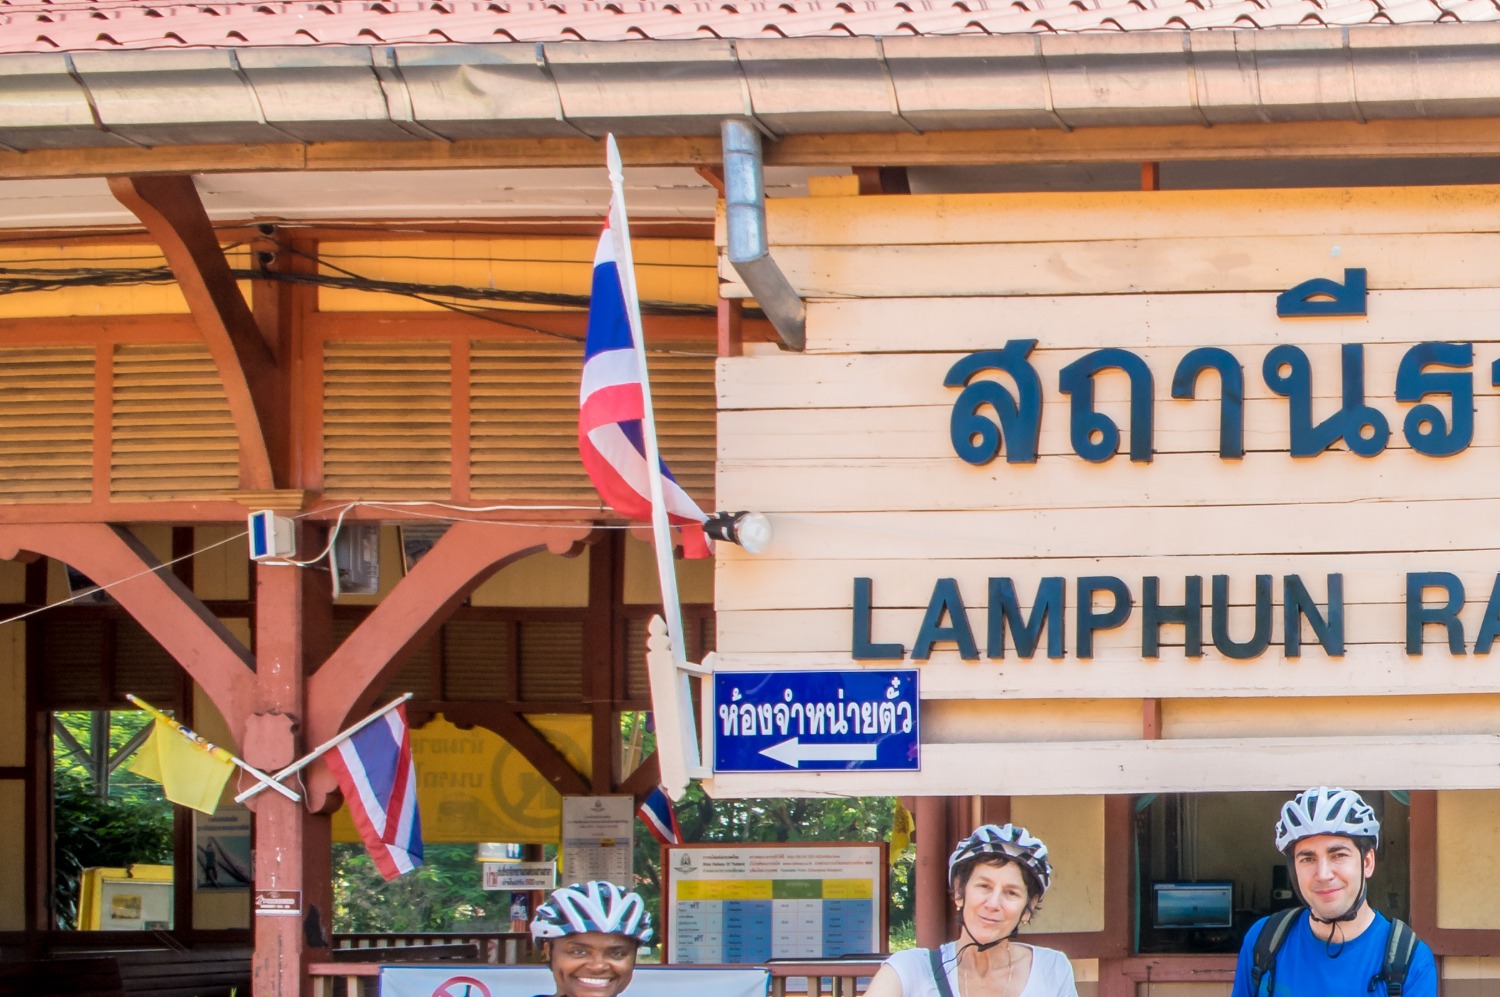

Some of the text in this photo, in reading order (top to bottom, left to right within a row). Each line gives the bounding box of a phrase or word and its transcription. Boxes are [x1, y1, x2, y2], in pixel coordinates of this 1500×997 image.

[851, 573, 1346, 661] LAMPHUN
[719, 676, 912, 736] ห้องจำหน่ายตั๋ว
